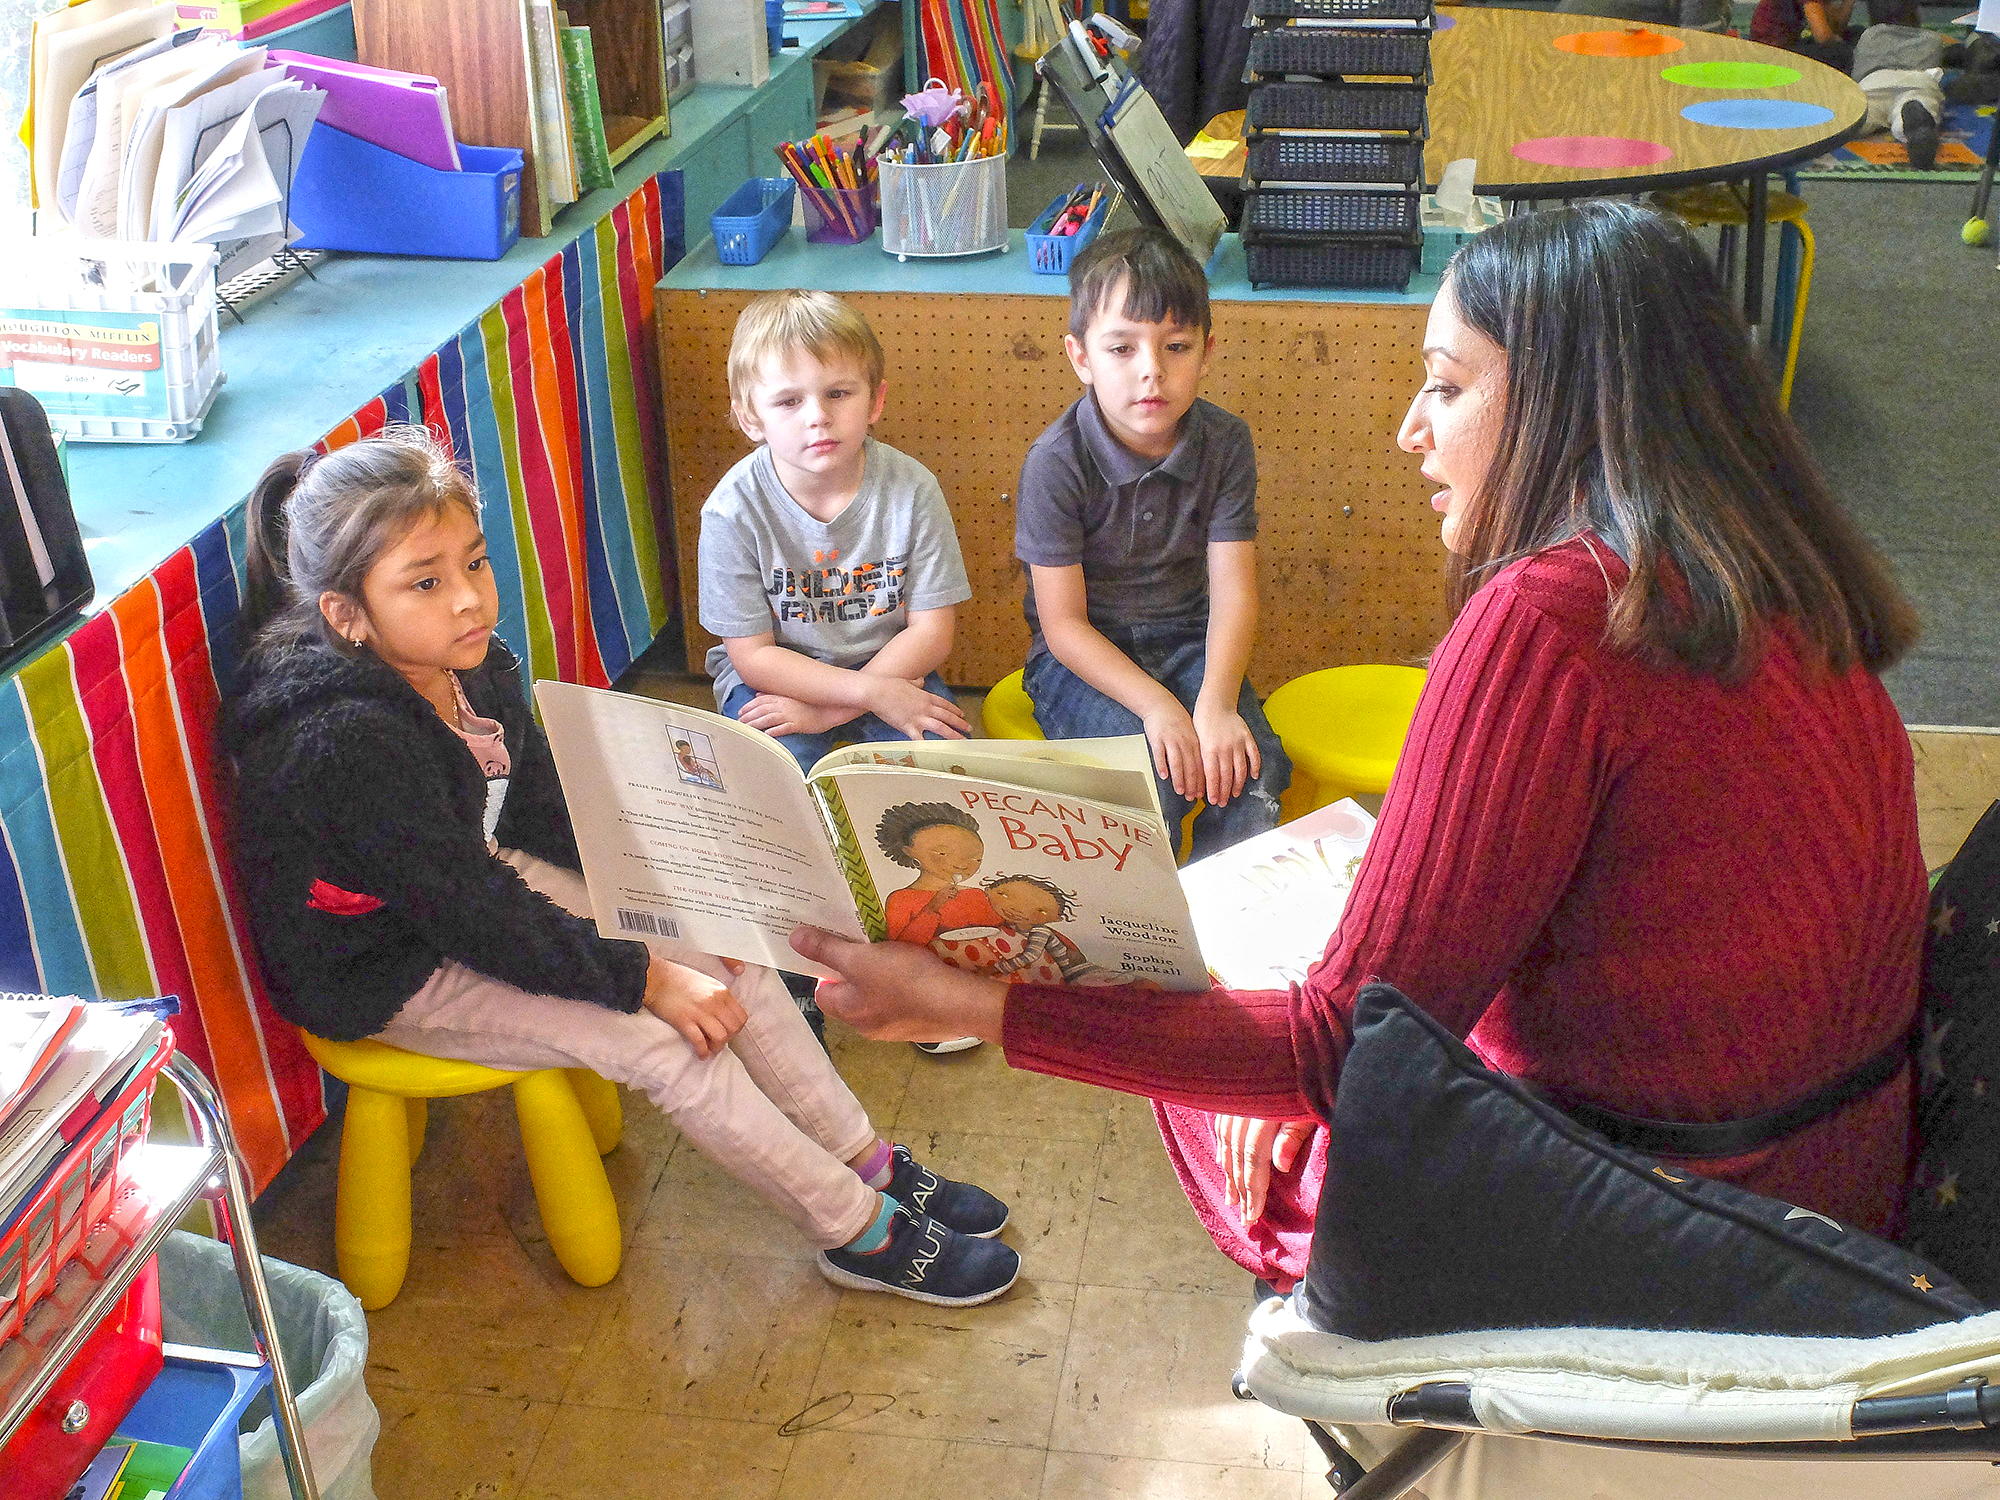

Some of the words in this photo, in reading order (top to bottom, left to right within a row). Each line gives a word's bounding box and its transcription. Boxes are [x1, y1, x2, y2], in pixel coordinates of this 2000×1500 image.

[90, 330, 151, 342] MIFFLIN
[1, 340, 88, 361] Vocabulary
[91, 347, 152, 363] Readers
[64, 375, 88, 383] Grade
[627, 781, 648, 789] PRAISE
[664, 788, 700, 799] JACQUELINE
[738, 806, 762, 816] PICTURE
[656, 798, 677, 807] SHOW
[664, 817, 689, 827] remarkable
[690, 822, 704, 830] books
[960, 790, 1086, 825] PECAN
[1100, 814, 1153, 847] PIE
[649, 838, 678, 849] COMING
[691, 847, 712, 856] HOME
[712, 852, 733, 860] SOON
[999, 816, 1133, 871] Baby
[672, 884, 685, 892] THE
[688, 887, 712, 897] OTHER
[1100, 915, 1179, 936] Jacqueline
[1106, 926, 1177, 944] Woodson
[1123, 952, 1174, 966] Sophie
[1120, 962, 1181, 976] Blackall
